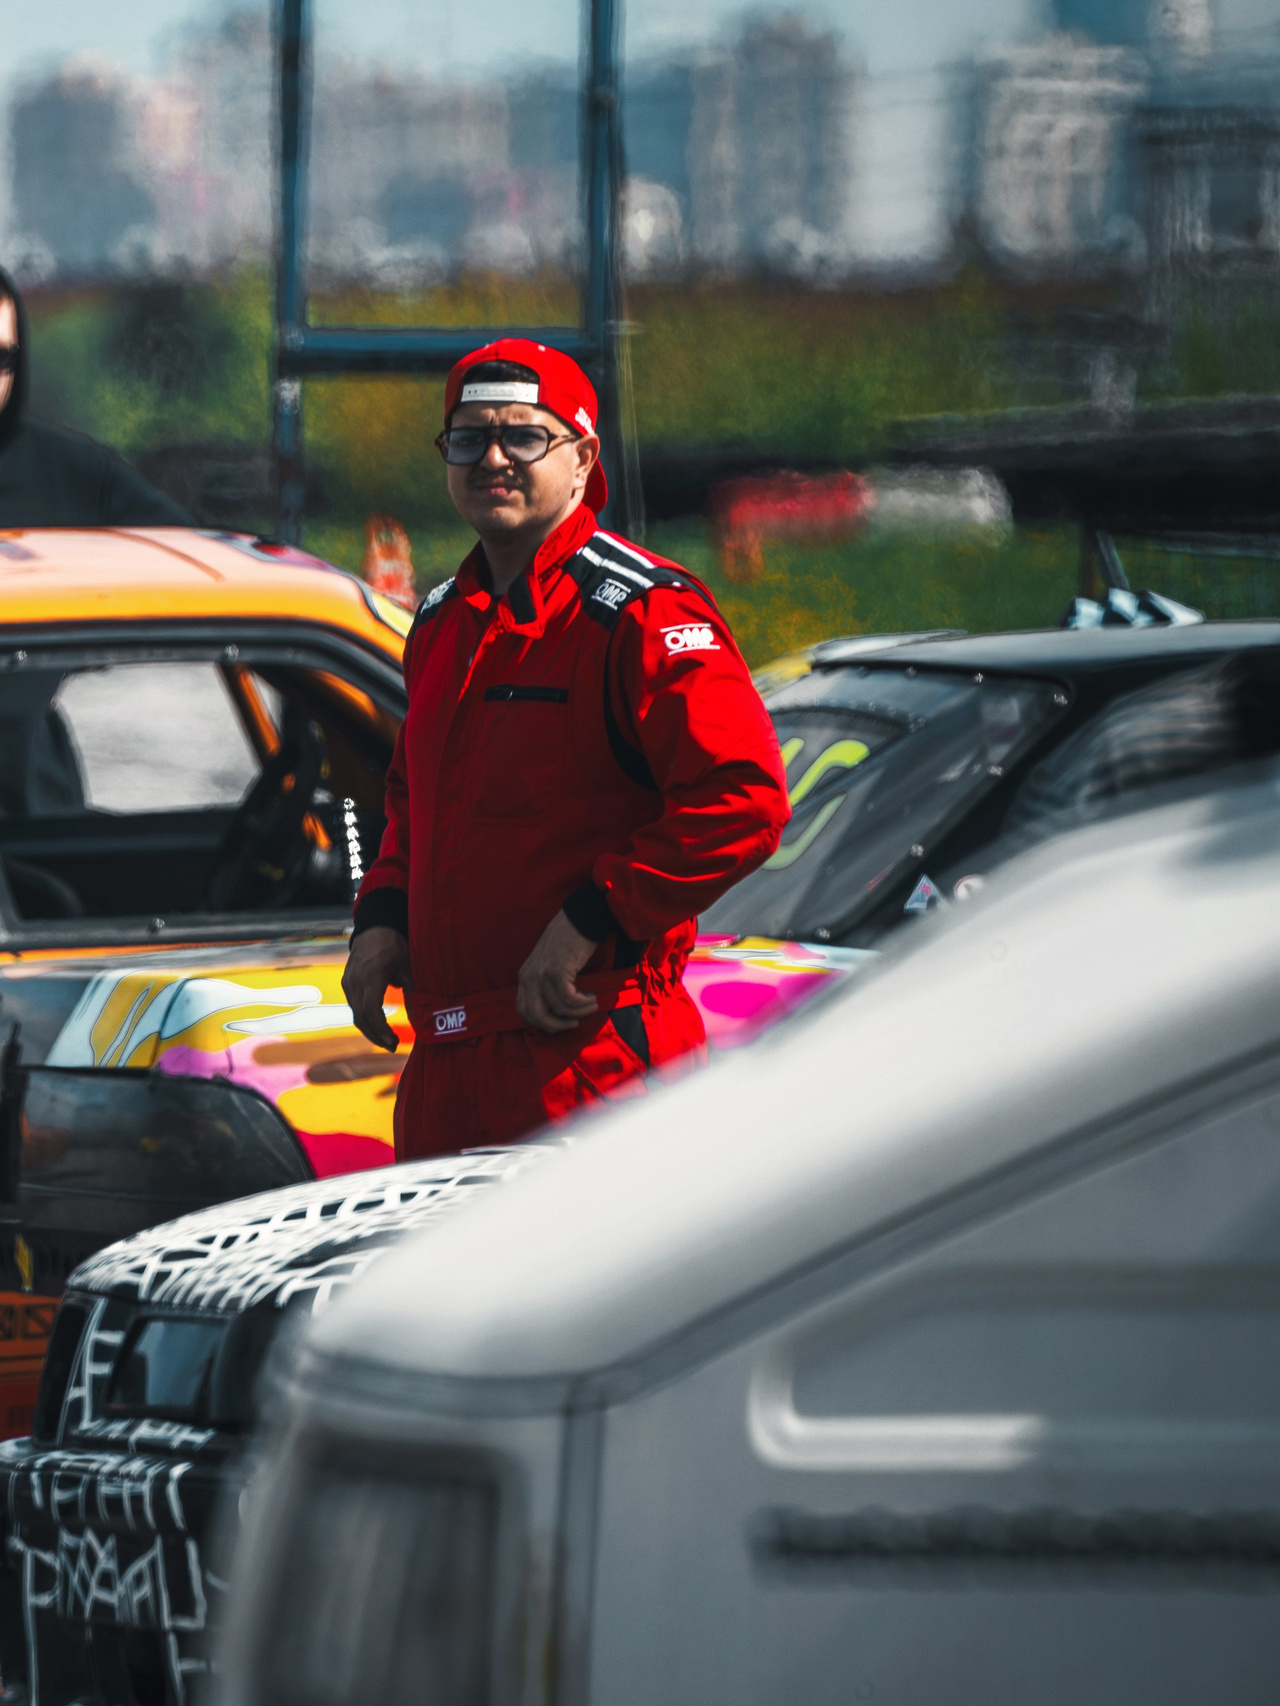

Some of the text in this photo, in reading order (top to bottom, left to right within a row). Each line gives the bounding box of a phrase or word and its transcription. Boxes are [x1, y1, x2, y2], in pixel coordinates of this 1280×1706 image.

[594, 581, 628, 607] OMP
[663, 626, 715, 652] OMP
[435, 1009, 466, 1031] OMP
